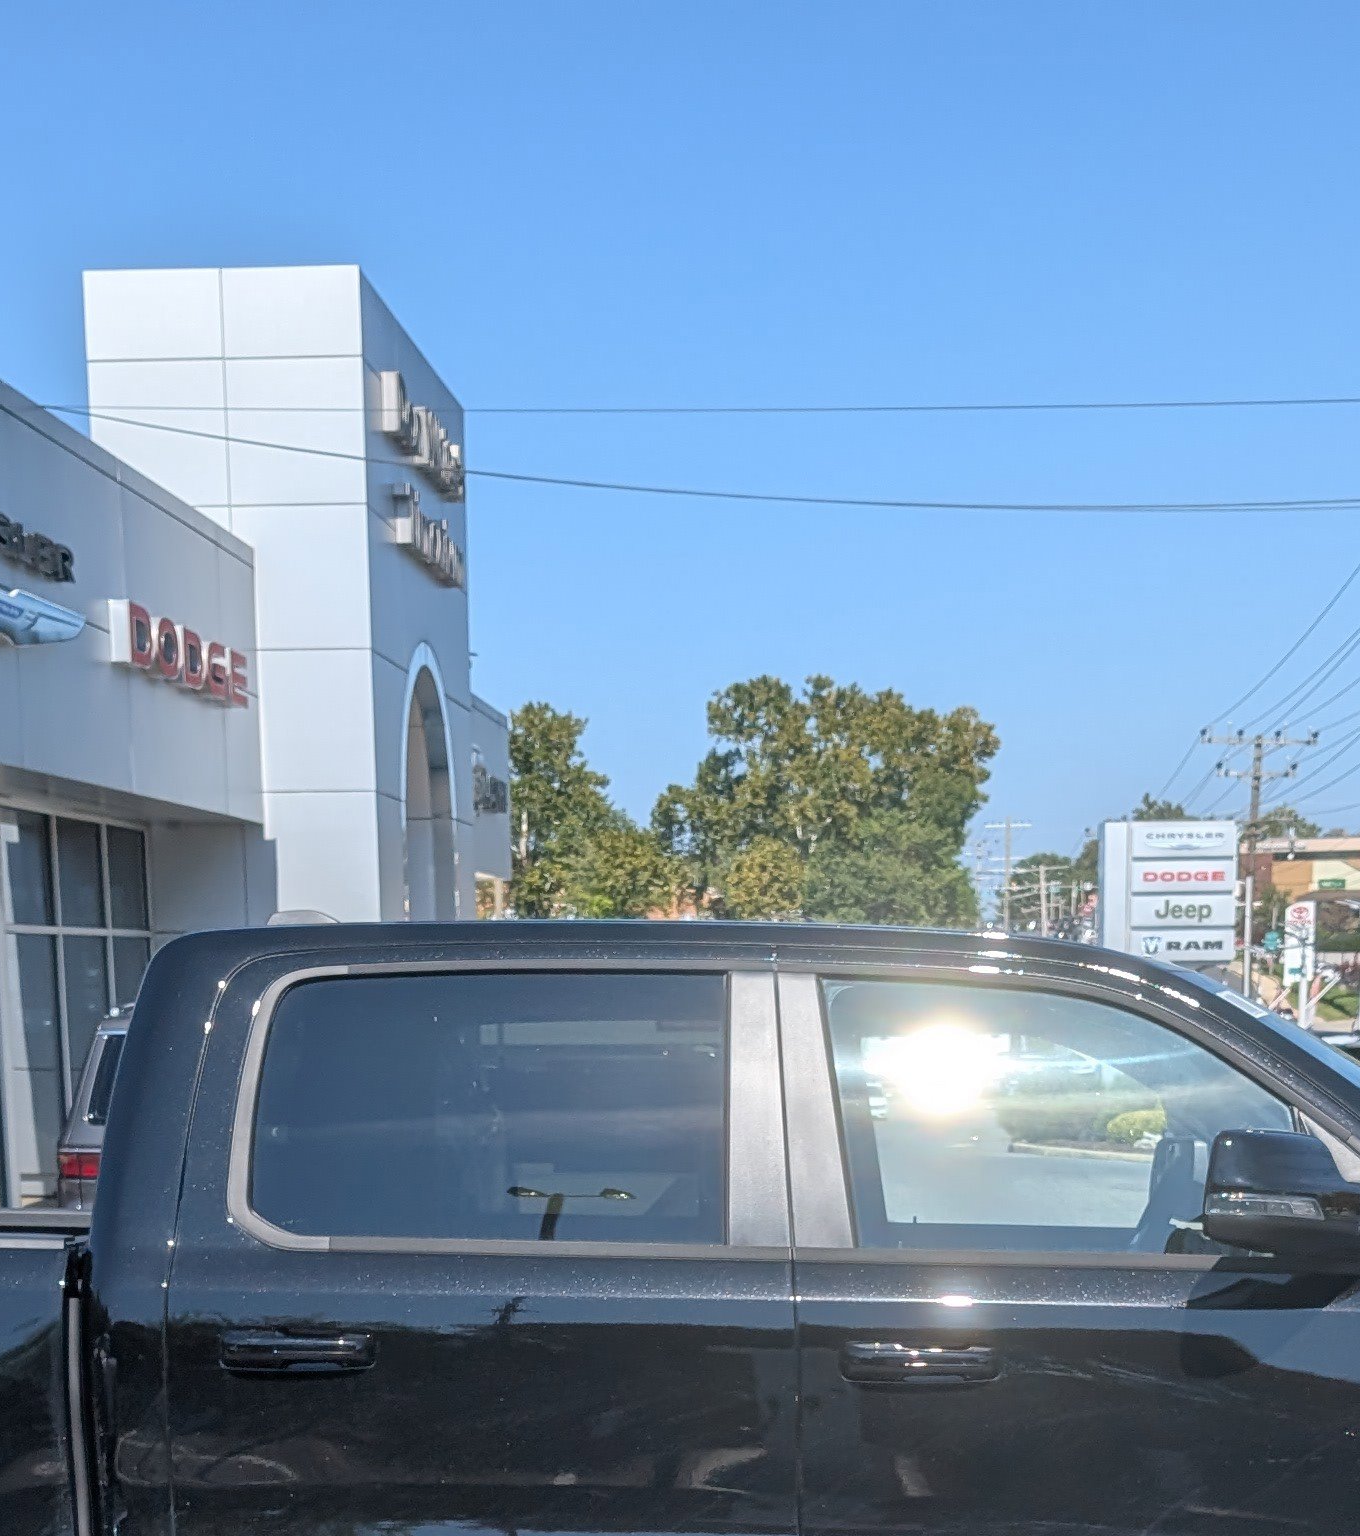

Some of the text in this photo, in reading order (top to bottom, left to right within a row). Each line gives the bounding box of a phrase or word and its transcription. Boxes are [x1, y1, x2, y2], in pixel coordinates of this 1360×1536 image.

[109, 599, 249, 708] DODGE
[1145, 832, 1225, 840] CHRYSLER
[1143, 871, 1225, 882] DODGE
[1154, 899, 1212, 923] Jeep
[1166, 940, 1223, 950] RAM
